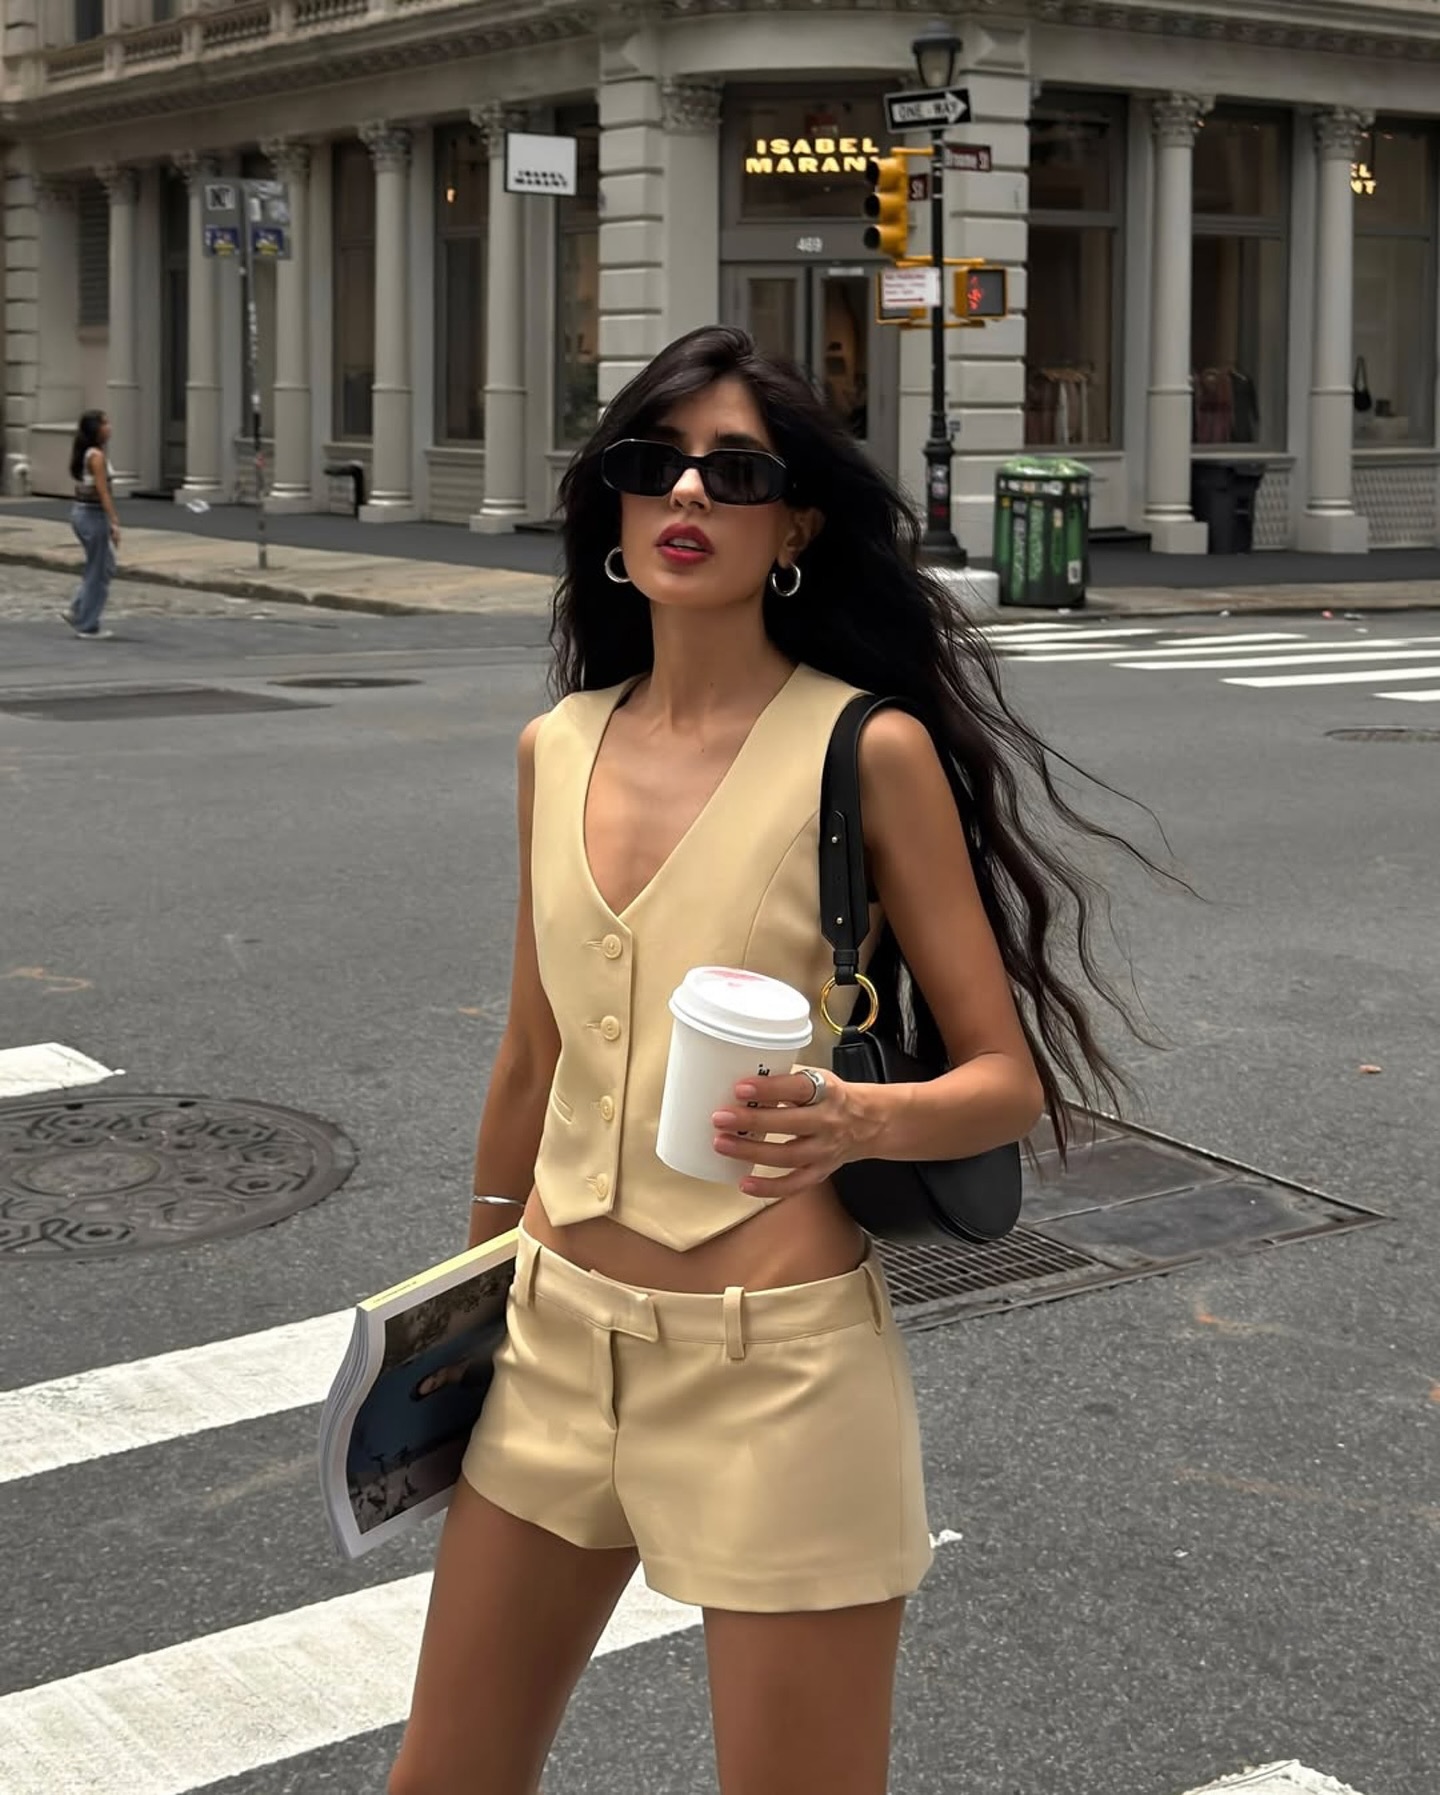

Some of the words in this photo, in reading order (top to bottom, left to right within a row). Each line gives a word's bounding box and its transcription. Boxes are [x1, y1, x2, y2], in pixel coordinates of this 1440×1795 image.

[898, 104, 923, 120] ONE
[933, 101, 958, 116] WAY
[756, 138, 879, 154] ISABEL
[746, 156, 879, 173] MARAN
